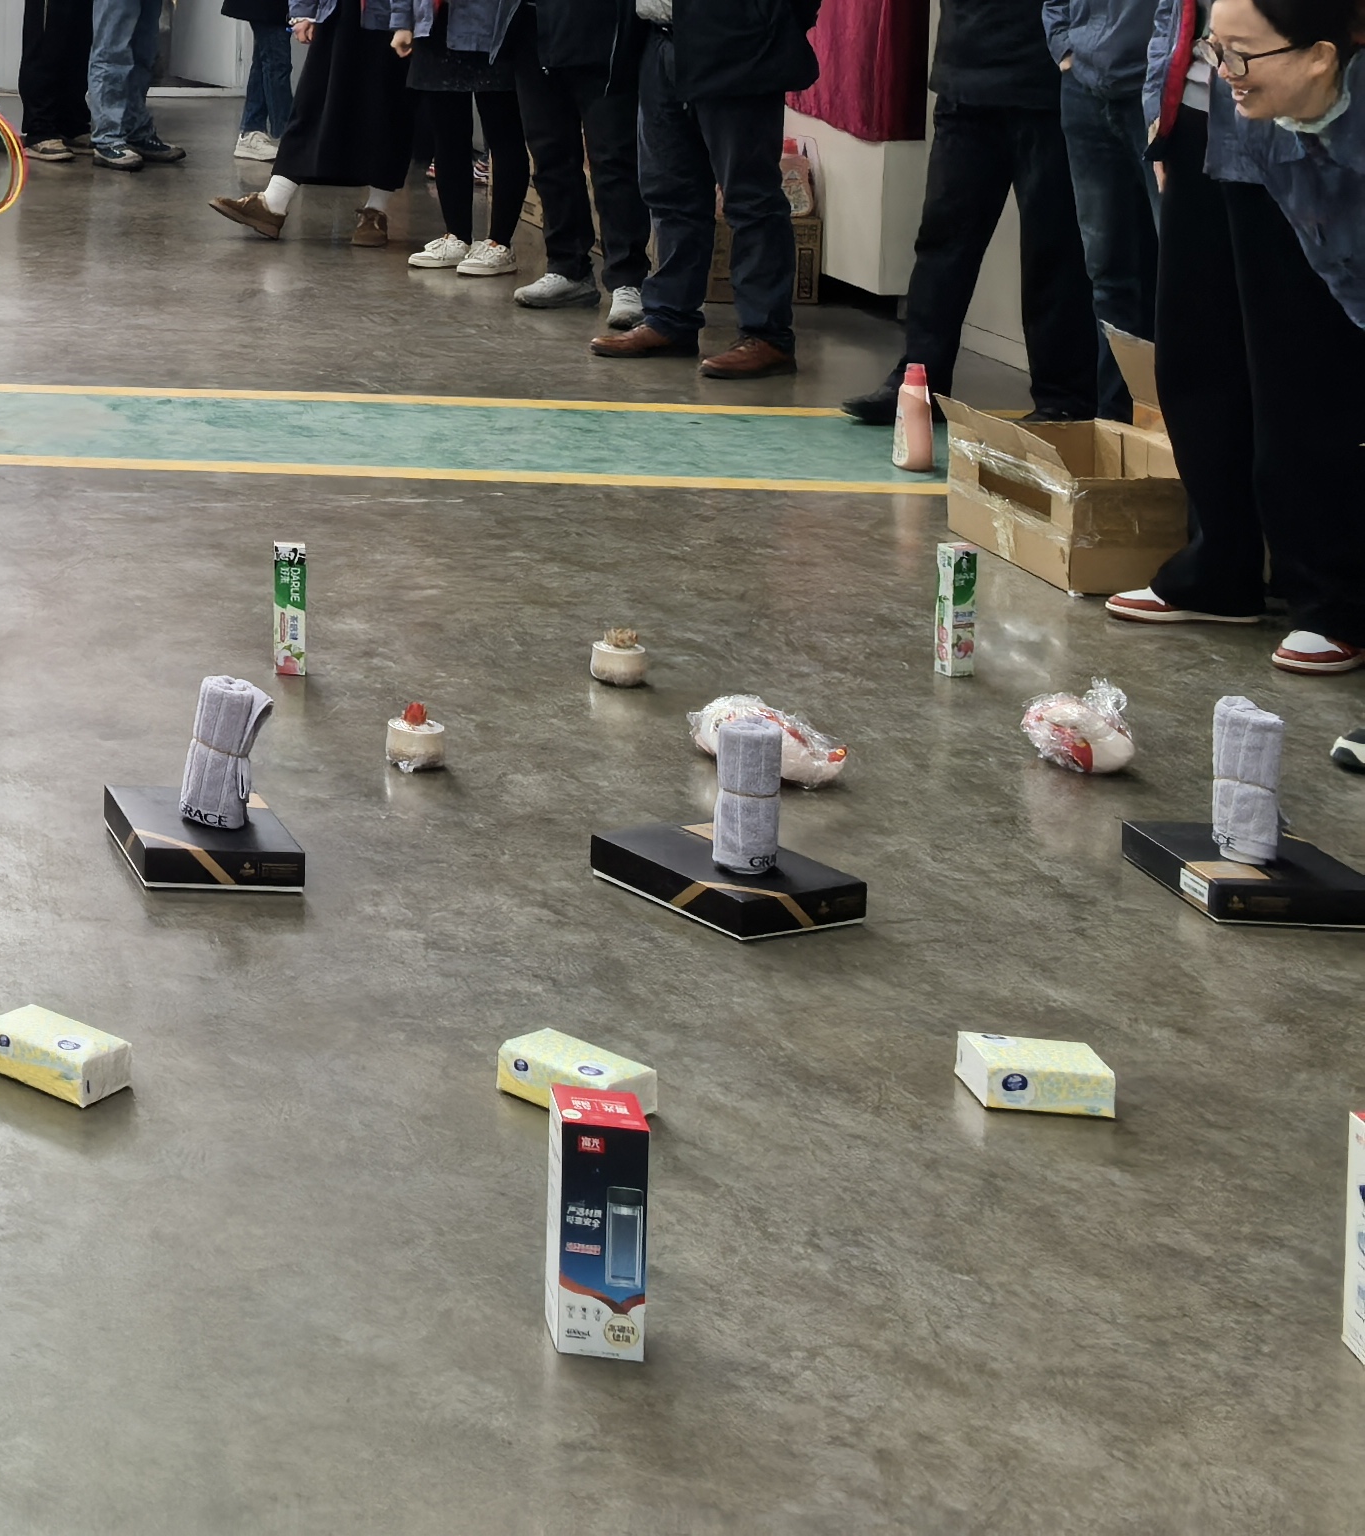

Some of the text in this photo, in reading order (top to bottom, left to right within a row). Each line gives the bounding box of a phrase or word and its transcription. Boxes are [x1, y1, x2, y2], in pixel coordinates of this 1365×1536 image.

[290, 566, 301, 602] DARLIE
[601, 1102, 630, 1115] 富光
[581, 1136, 600, 1148] 富光
